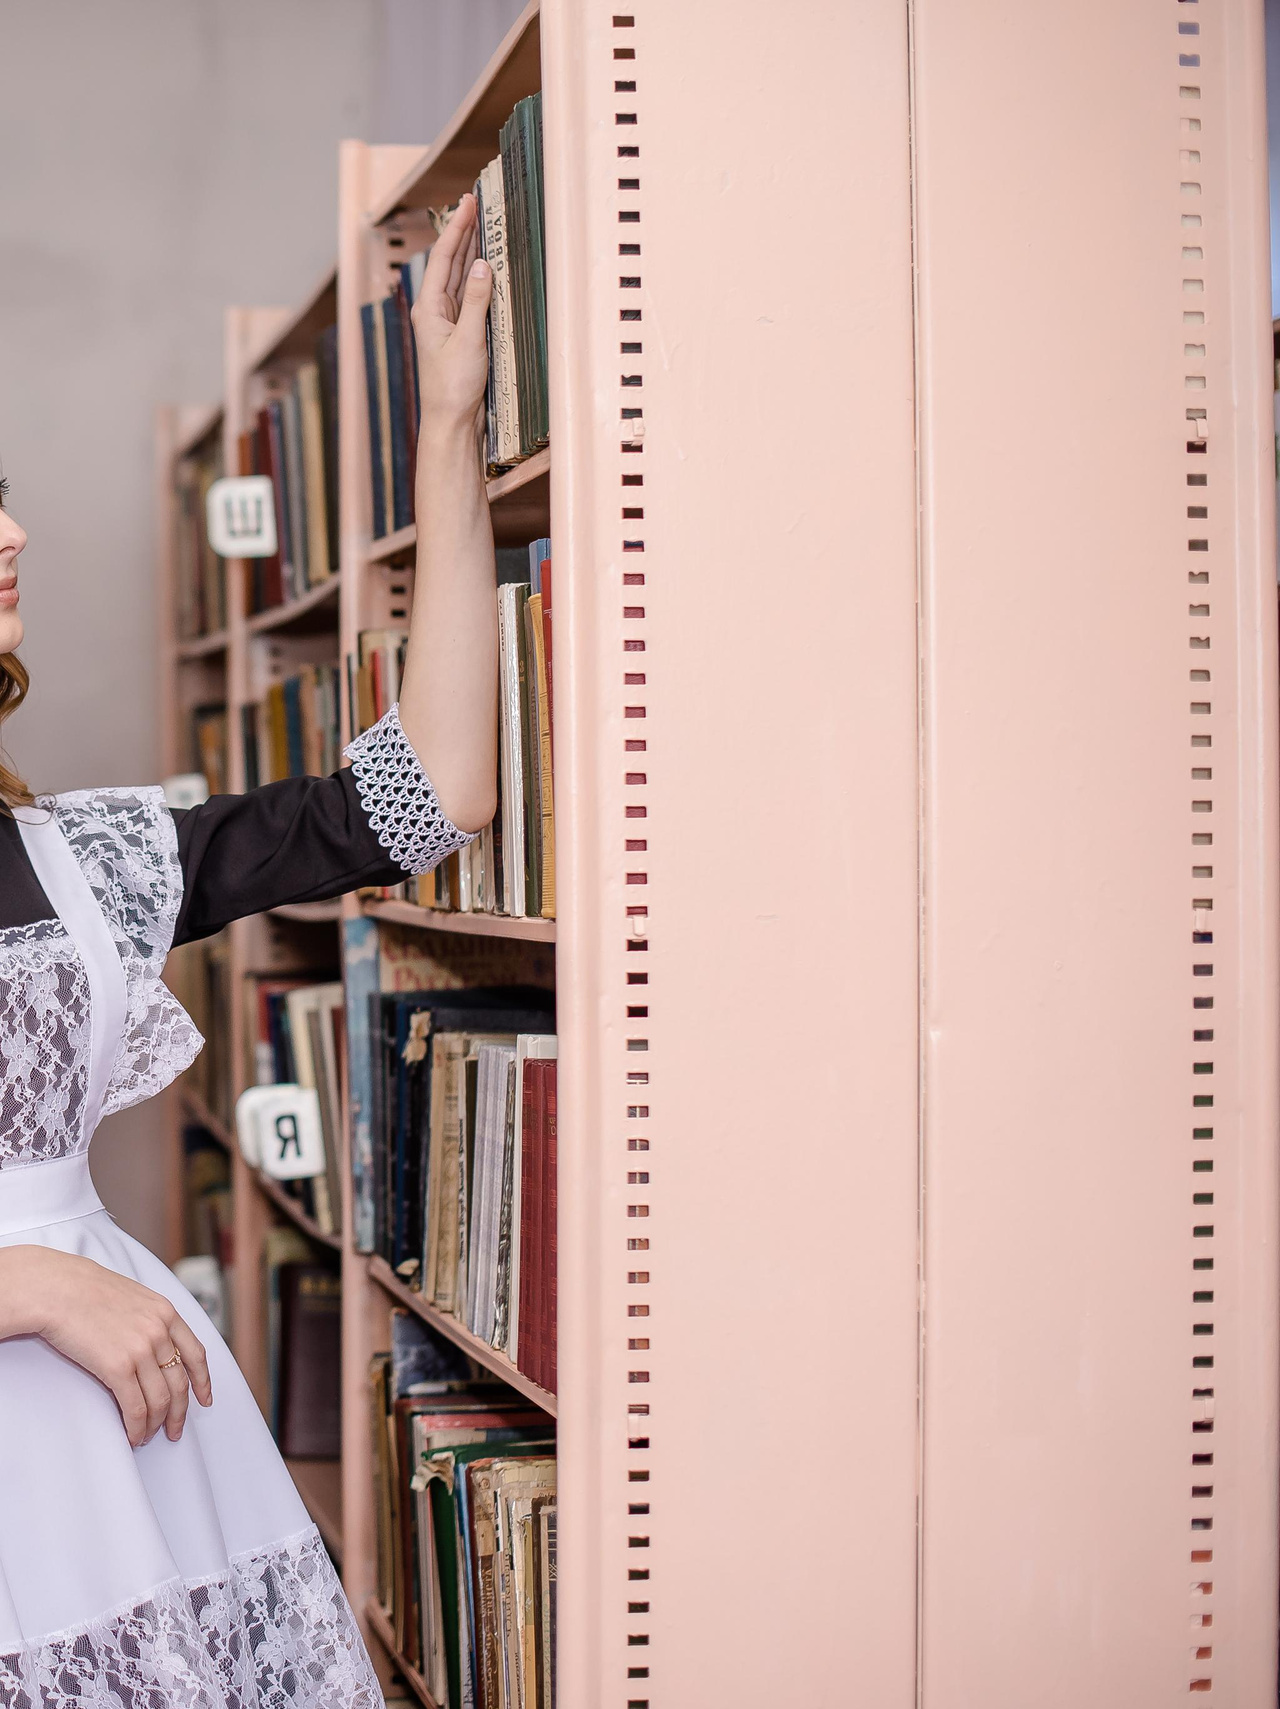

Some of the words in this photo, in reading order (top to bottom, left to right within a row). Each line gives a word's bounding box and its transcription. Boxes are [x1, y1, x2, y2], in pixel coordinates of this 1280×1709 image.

[494, 215, 504, 272] ОВОД
[224, 495, 263, 538] Ш
[275, 1114, 301, 1159] Я
